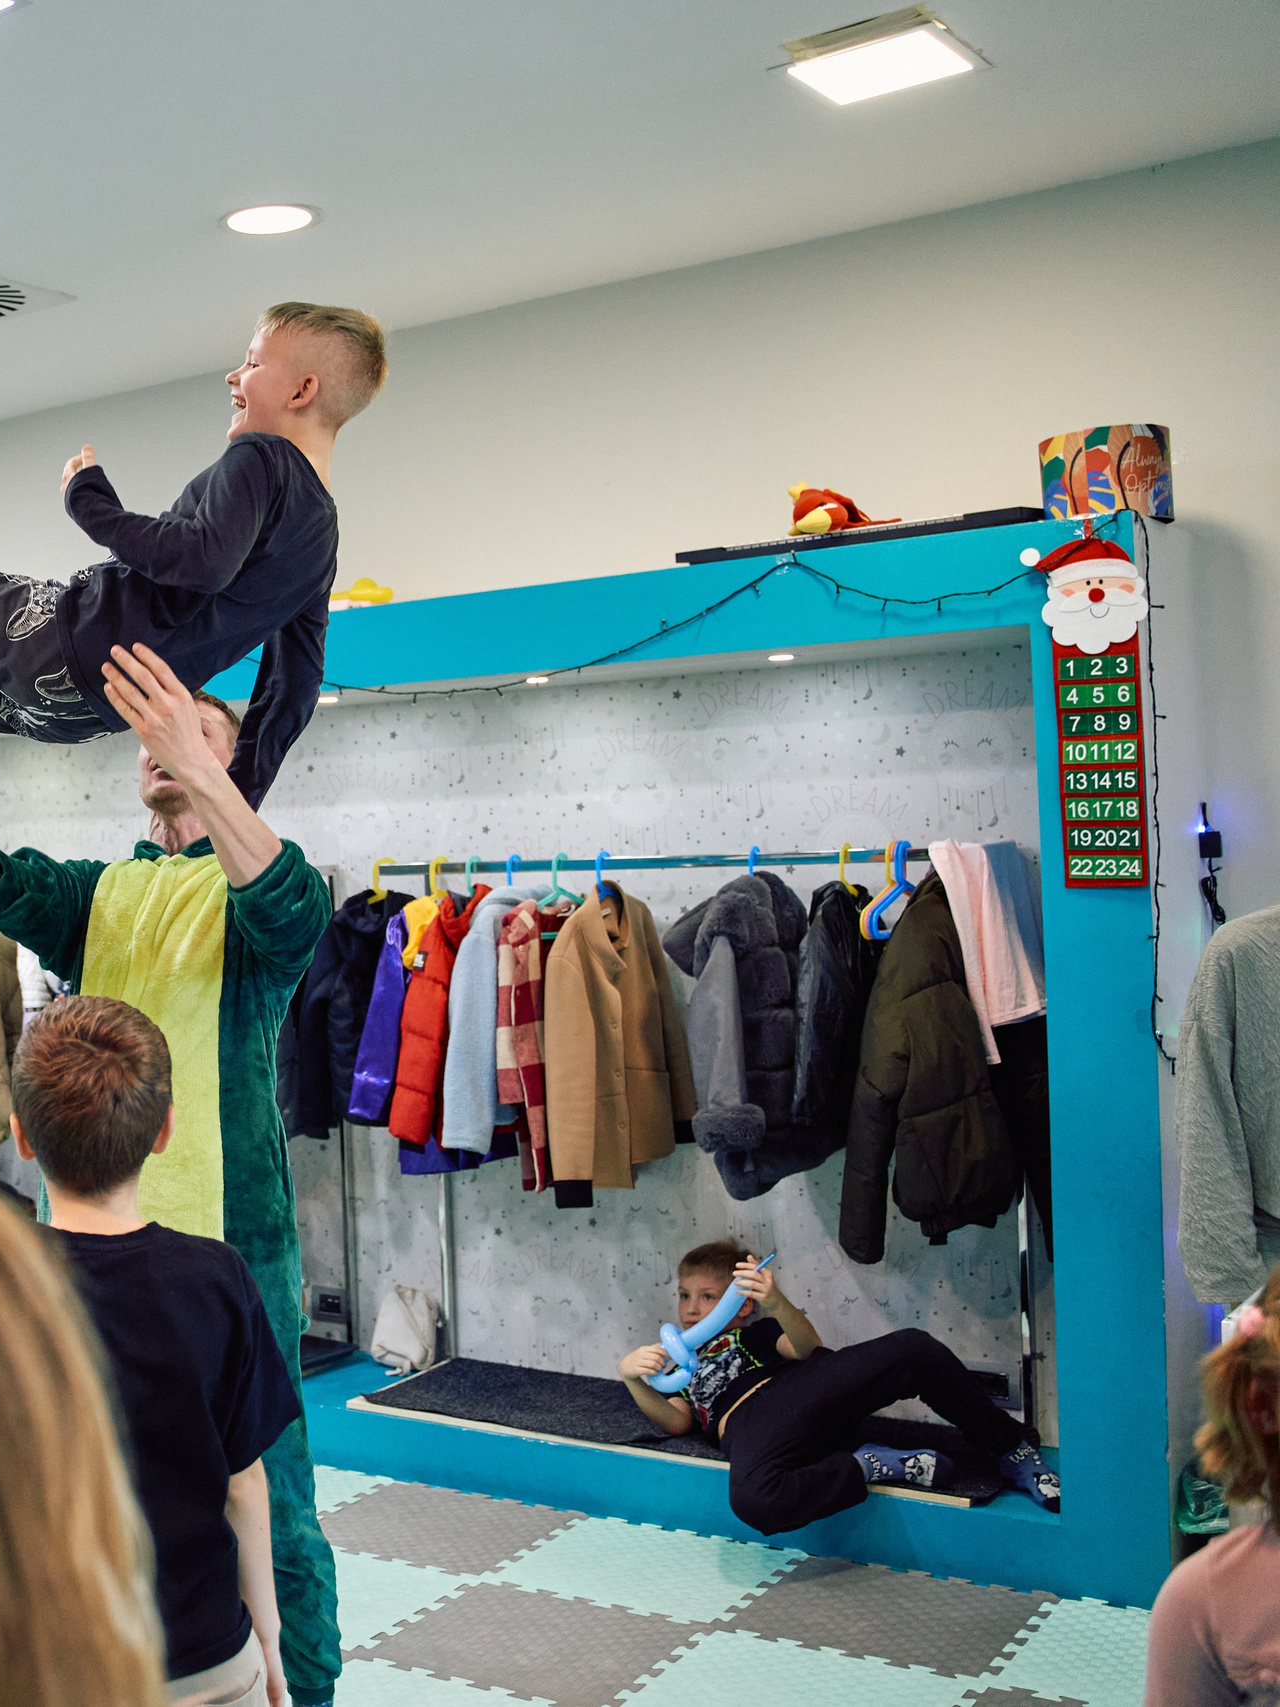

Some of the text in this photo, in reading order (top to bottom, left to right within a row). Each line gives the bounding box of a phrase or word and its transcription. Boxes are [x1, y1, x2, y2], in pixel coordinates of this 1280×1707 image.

[1121, 443, 1163, 474] Alway
[1066, 657, 1128, 677] 1 2 3
[698, 678, 790, 718] DREAM
[921, 677, 1028, 719] DREAM
[1066, 685, 1130, 705] 4 5 6
[1069, 713, 1131, 733] 7 8 9
[597, 725, 685, 761] DREAM
[1065, 742, 1136, 761] 10 11 12
[1066, 771, 1136, 790] 13 14 15
[809, 783, 908, 823] DREAM
[1068, 800, 1138, 818] 16 17 18
[1071, 829, 1140, 847] 19 20 21
[1070, 858, 1141, 876] 22 23 24
[516, 1243, 600, 1285] DREAM
